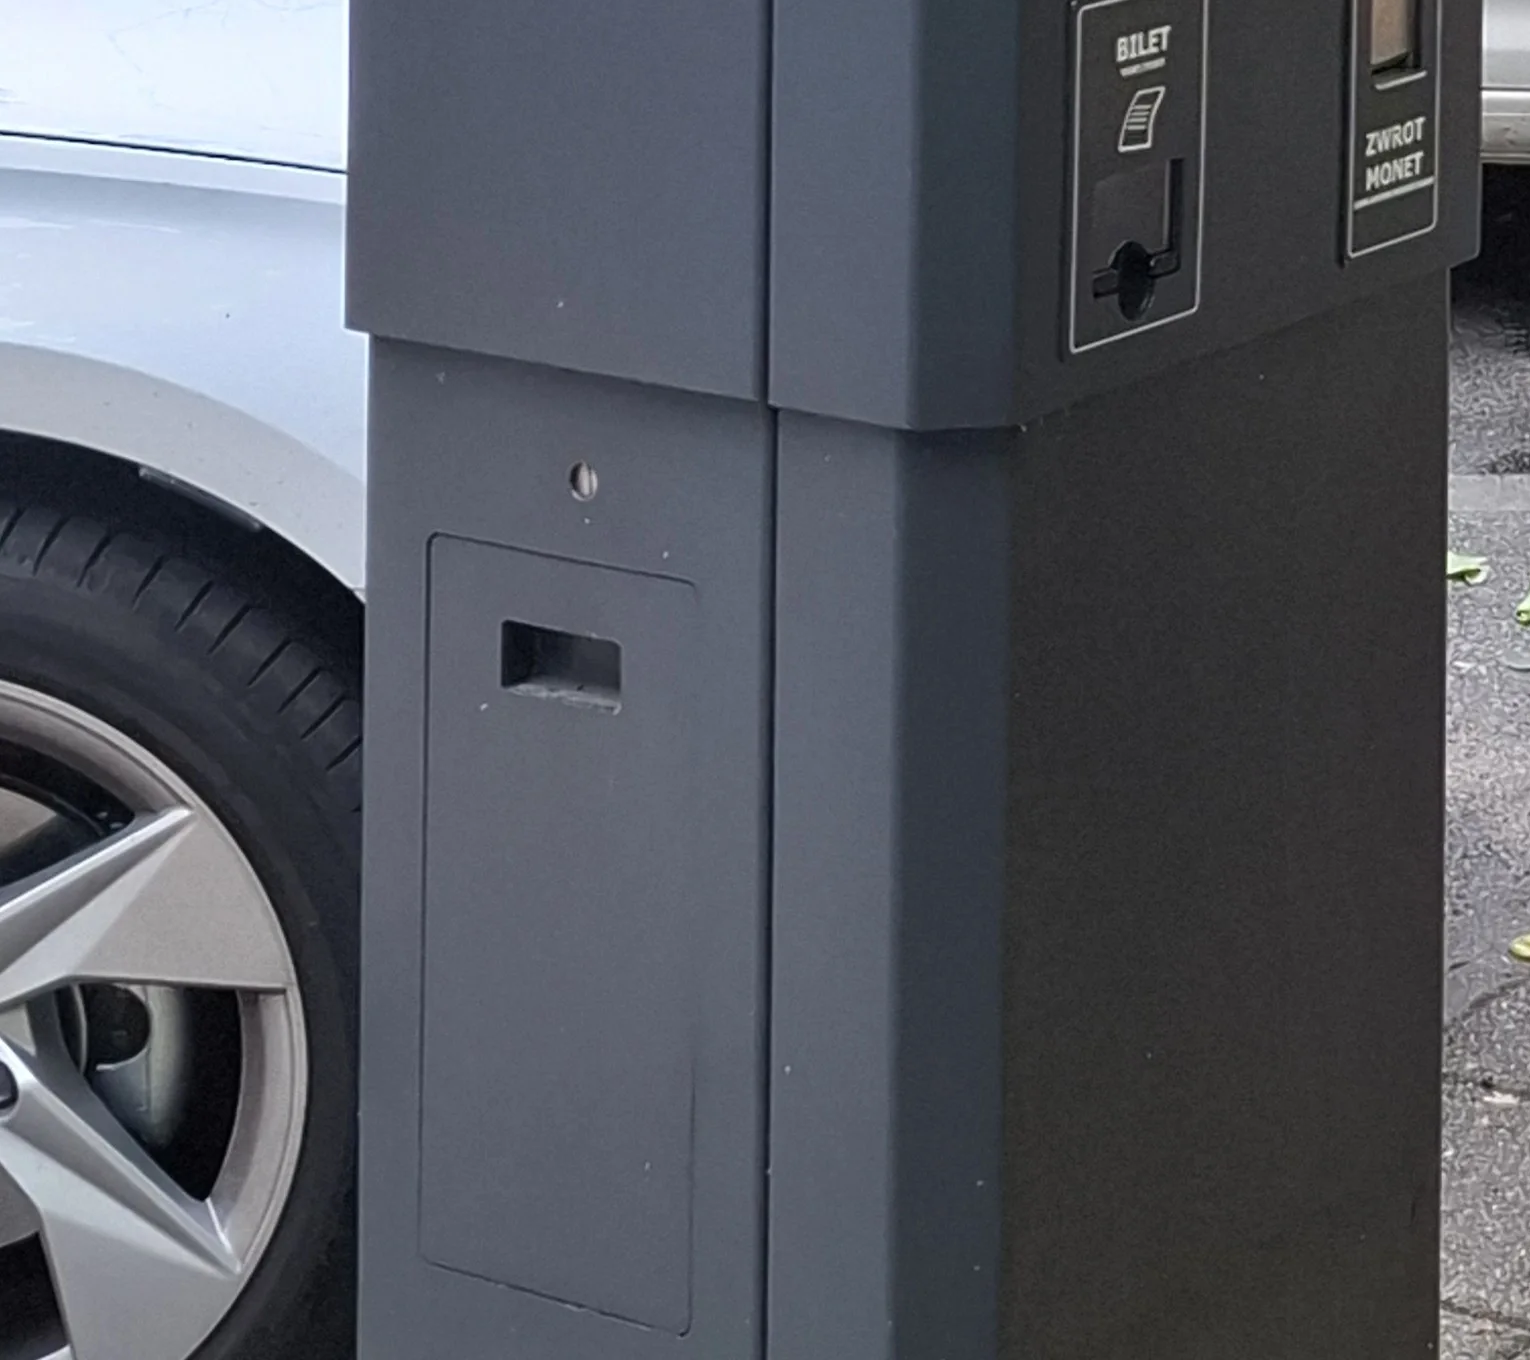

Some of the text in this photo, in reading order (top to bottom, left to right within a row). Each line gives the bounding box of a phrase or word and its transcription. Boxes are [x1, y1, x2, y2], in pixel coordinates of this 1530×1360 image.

[1116, 25, 1172, 62] BILET
[1365, 116, 1426, 157] ZWROT
[1365, 151, 1424, 192] MONET
